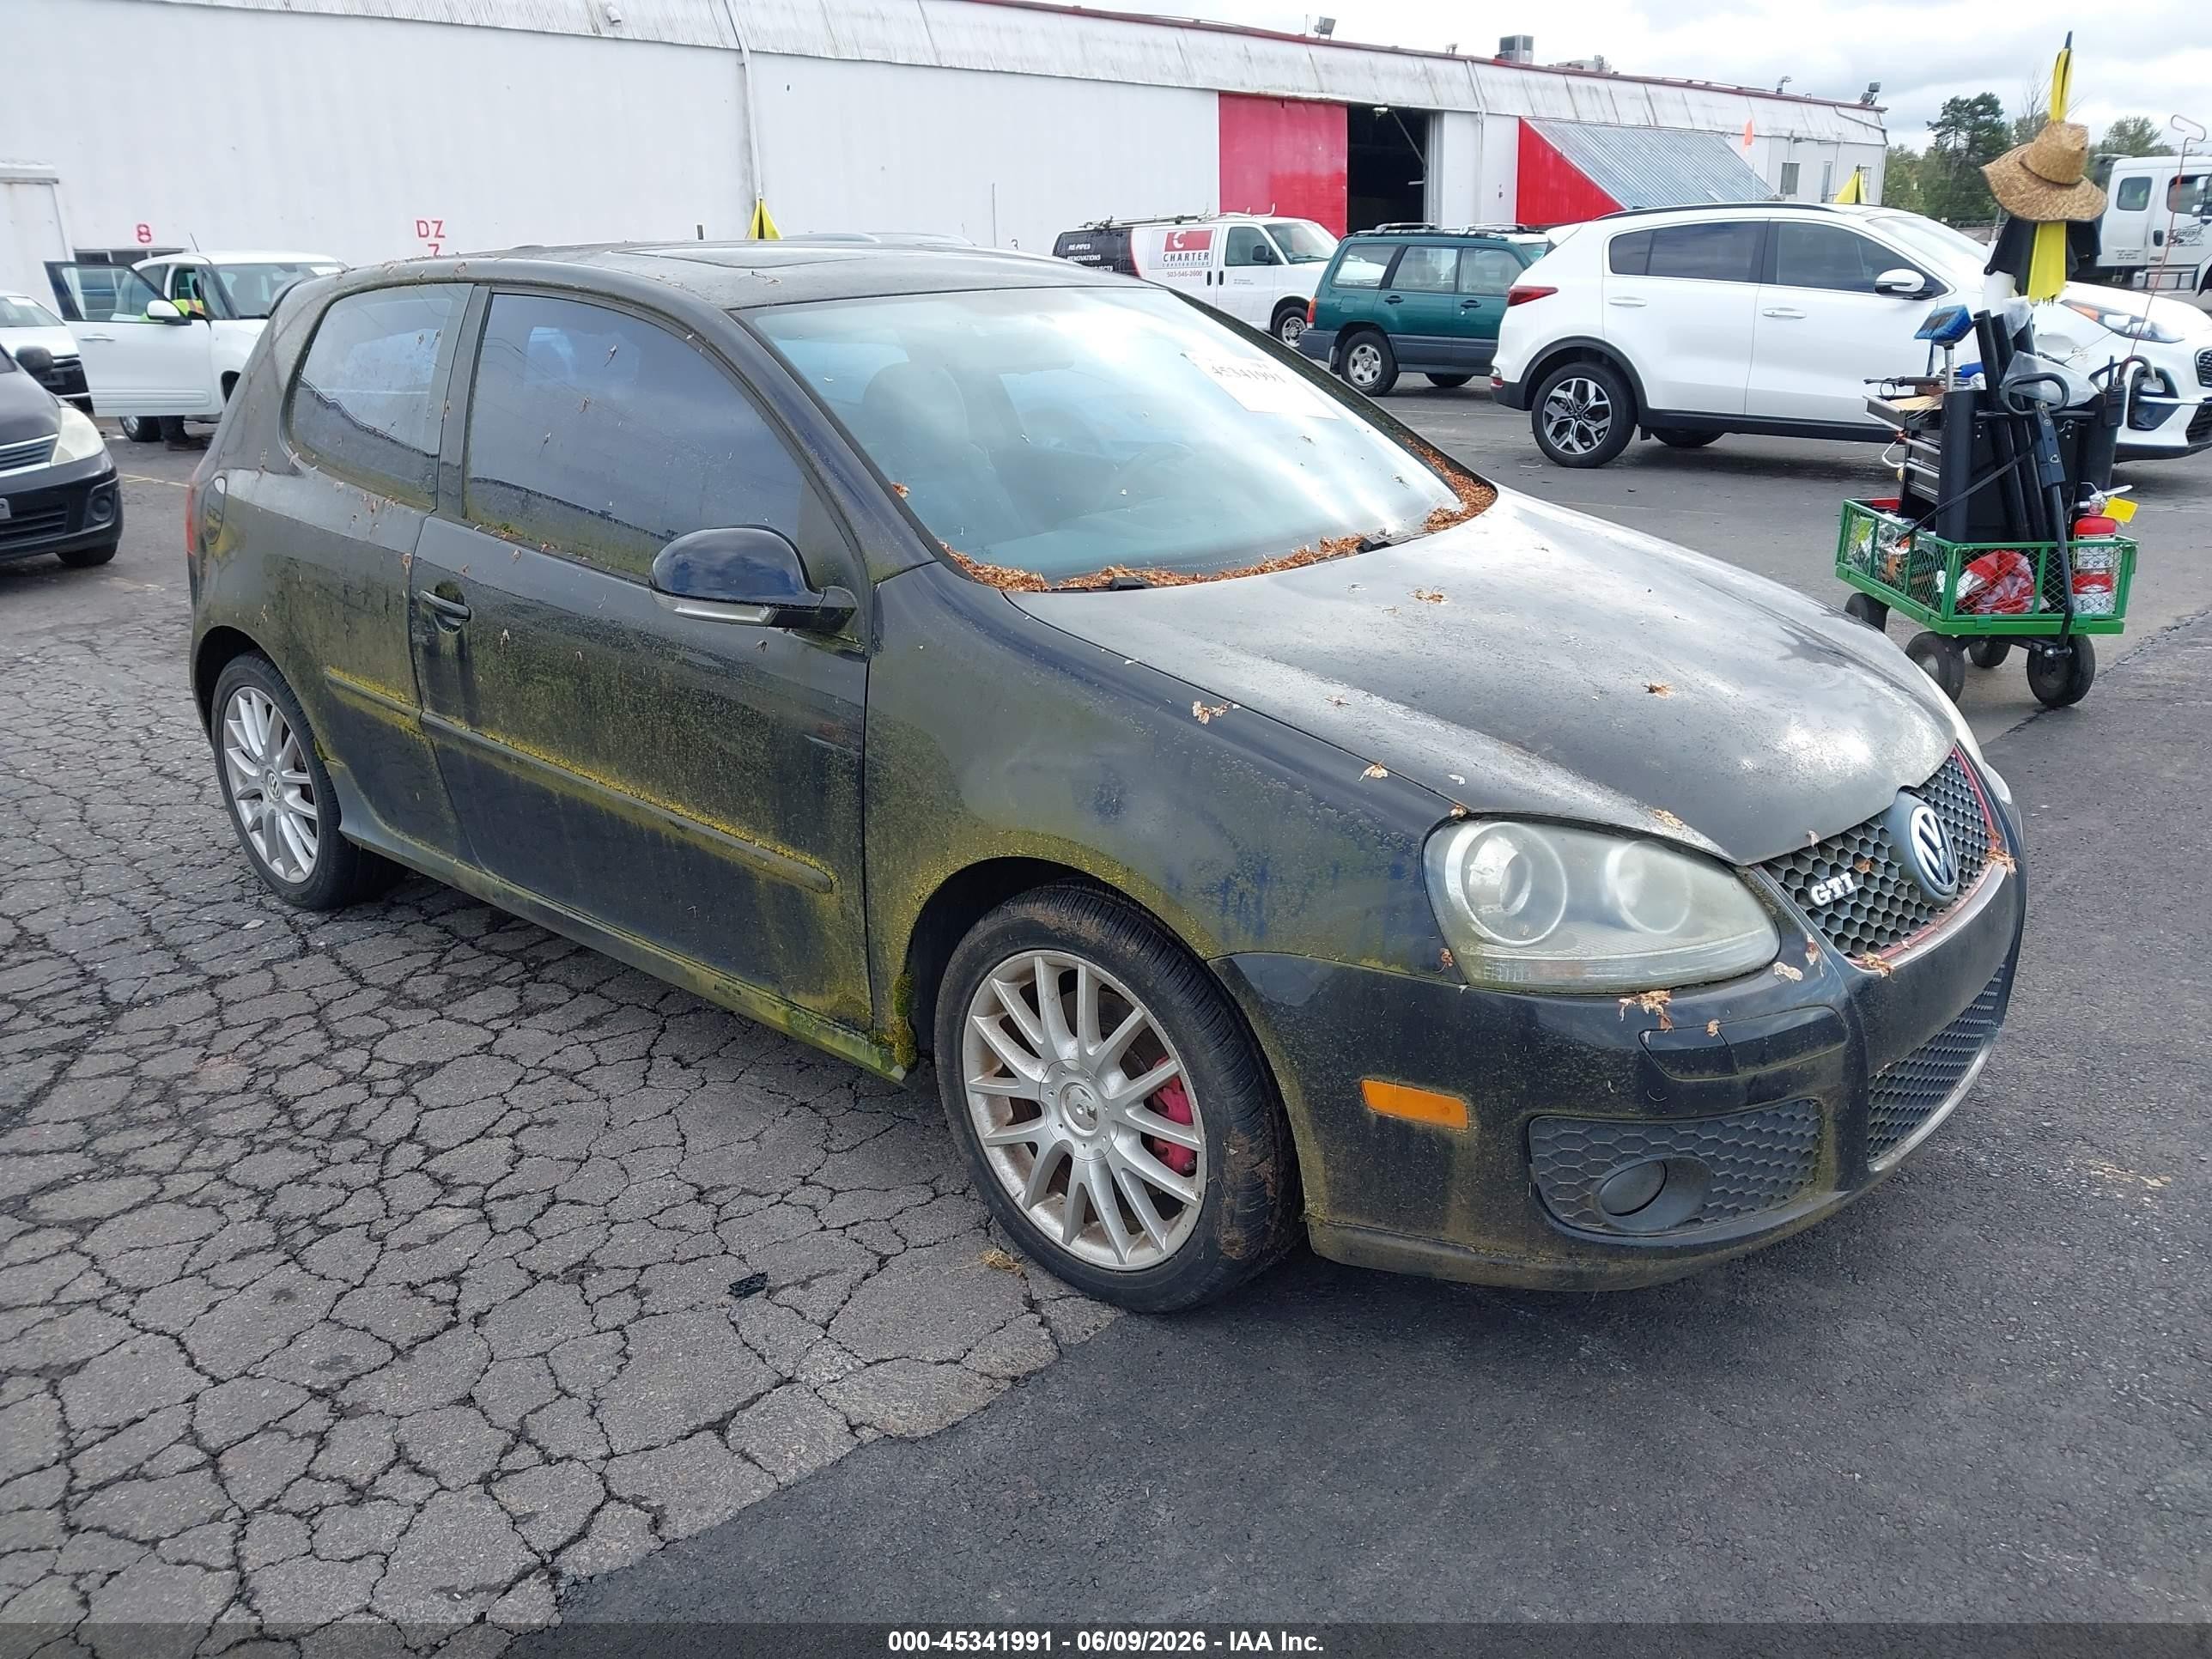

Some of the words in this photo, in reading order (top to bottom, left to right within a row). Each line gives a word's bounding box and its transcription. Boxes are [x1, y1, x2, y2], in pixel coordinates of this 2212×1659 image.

[137, 223, 152, 243] 8
[416, 220, 446, 238] DZ
[1164, 252, 1209, 262] CHARTER
[1810, 872, 1856, 906] GTI
